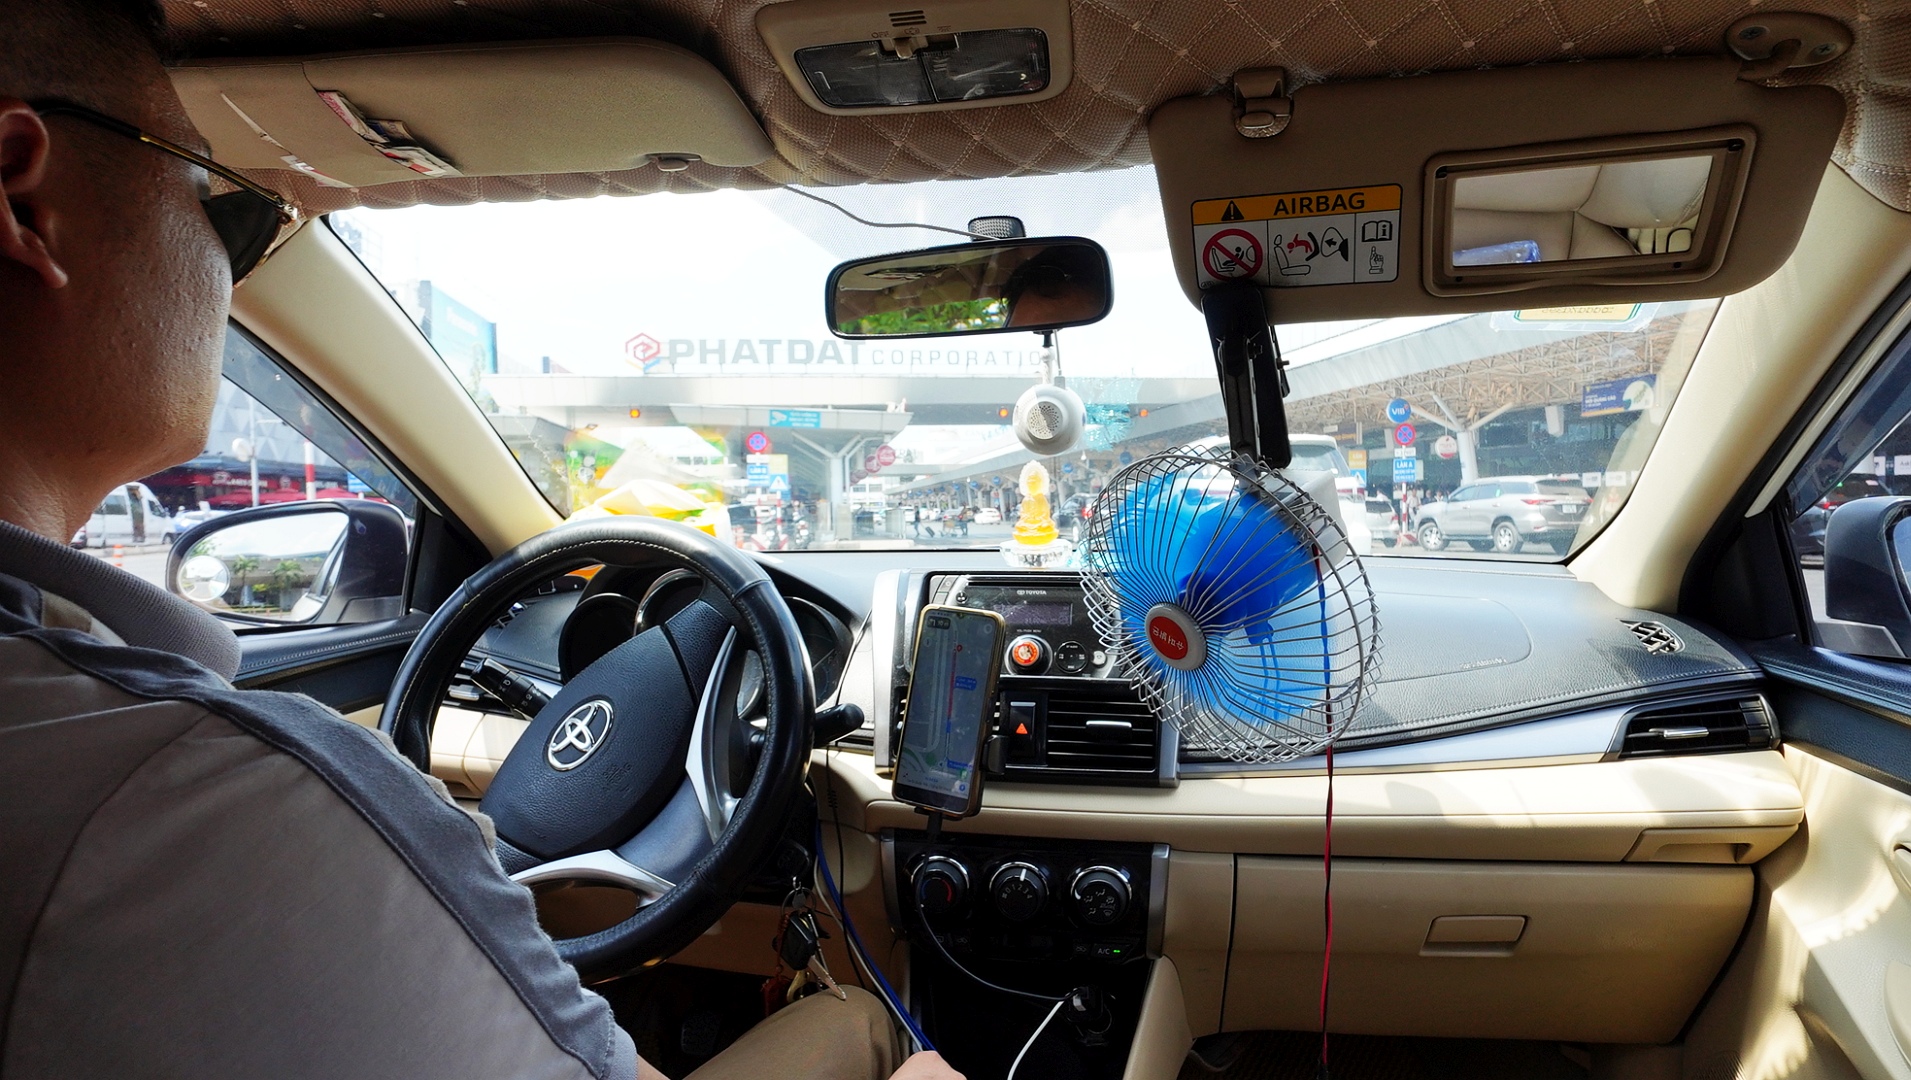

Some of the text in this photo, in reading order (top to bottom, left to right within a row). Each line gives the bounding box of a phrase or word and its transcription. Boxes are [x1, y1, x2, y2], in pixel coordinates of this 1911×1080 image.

[1273, 192, 1366, 216] AIRBAG
[668, 339, 1043, 366] PHATDAT CORPORATIO
[1391, 407, 1405, 416] VIB
[1097, 947, 1111, 955] A/C
